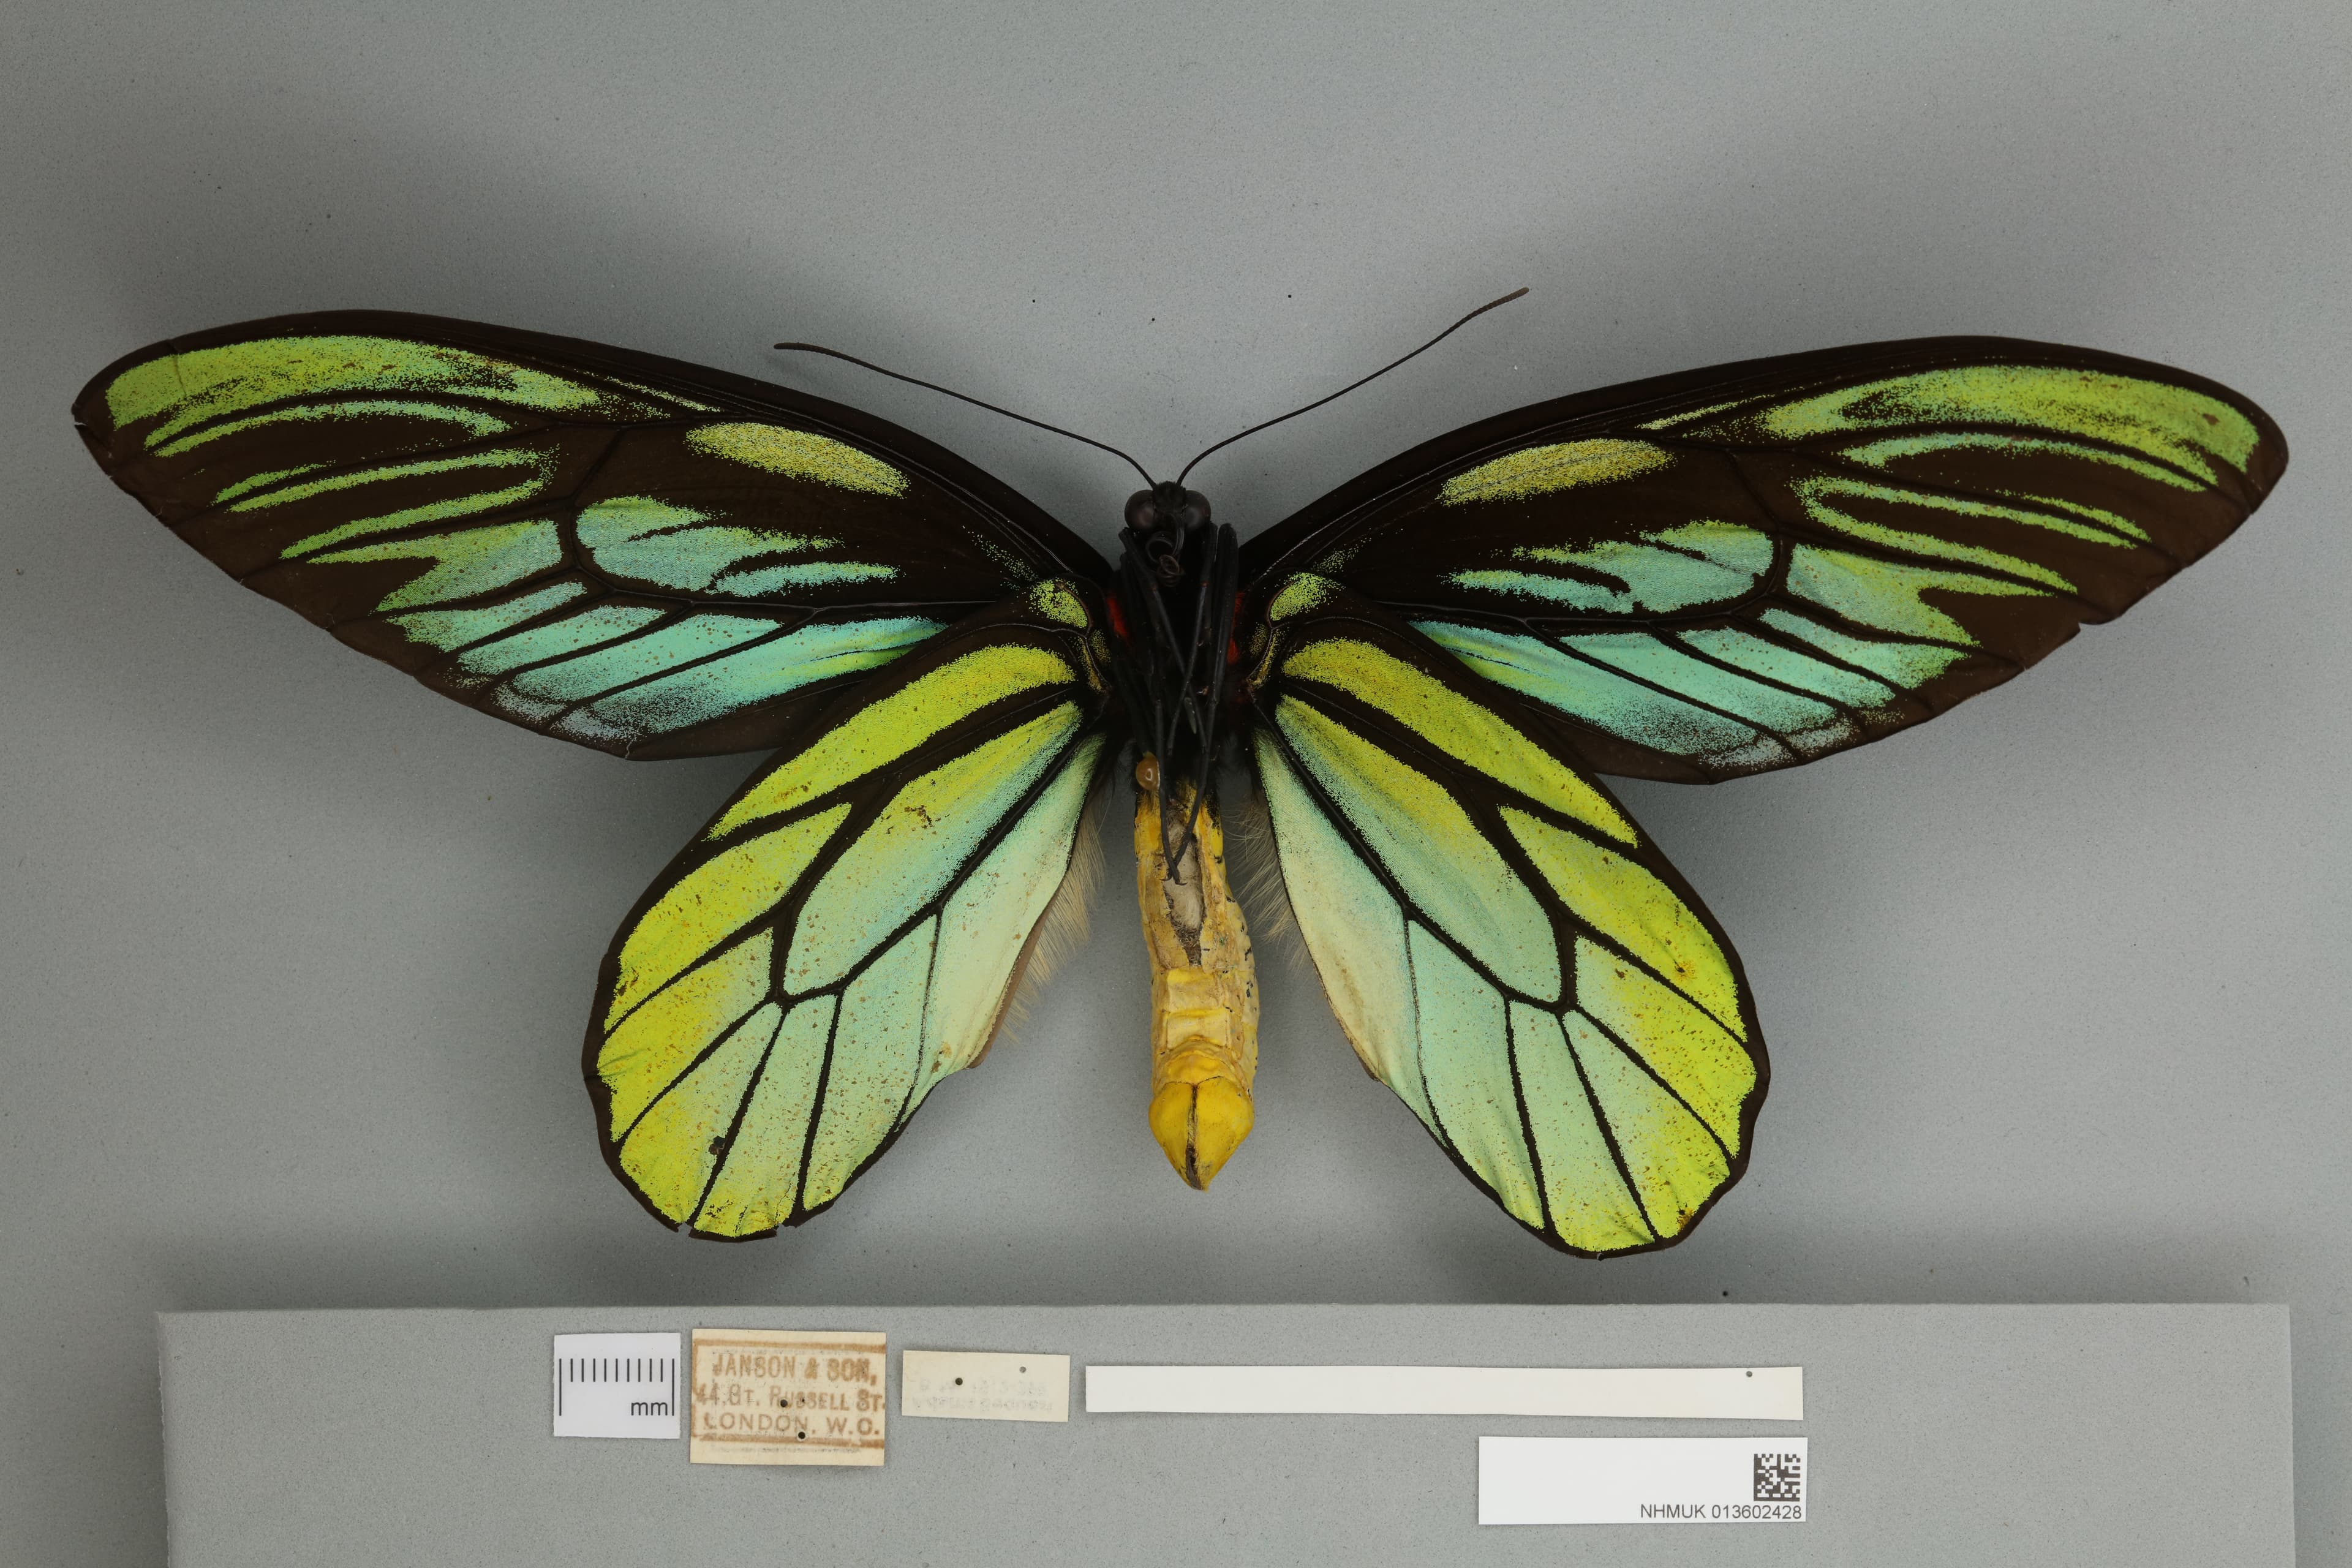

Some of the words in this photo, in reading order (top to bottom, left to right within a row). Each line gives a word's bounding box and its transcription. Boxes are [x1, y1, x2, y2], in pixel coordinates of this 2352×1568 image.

[712, 1352, 795, 1378] JANSON
[804, 1357, 819, 1380] &
[826, 1357, 878, 1386] SON,
[631, 1402, 668, 1416] mm
[1640, 1504, 1706, 1518] NHMUK
[1711, 1504, 1802, 1519] 013602428
